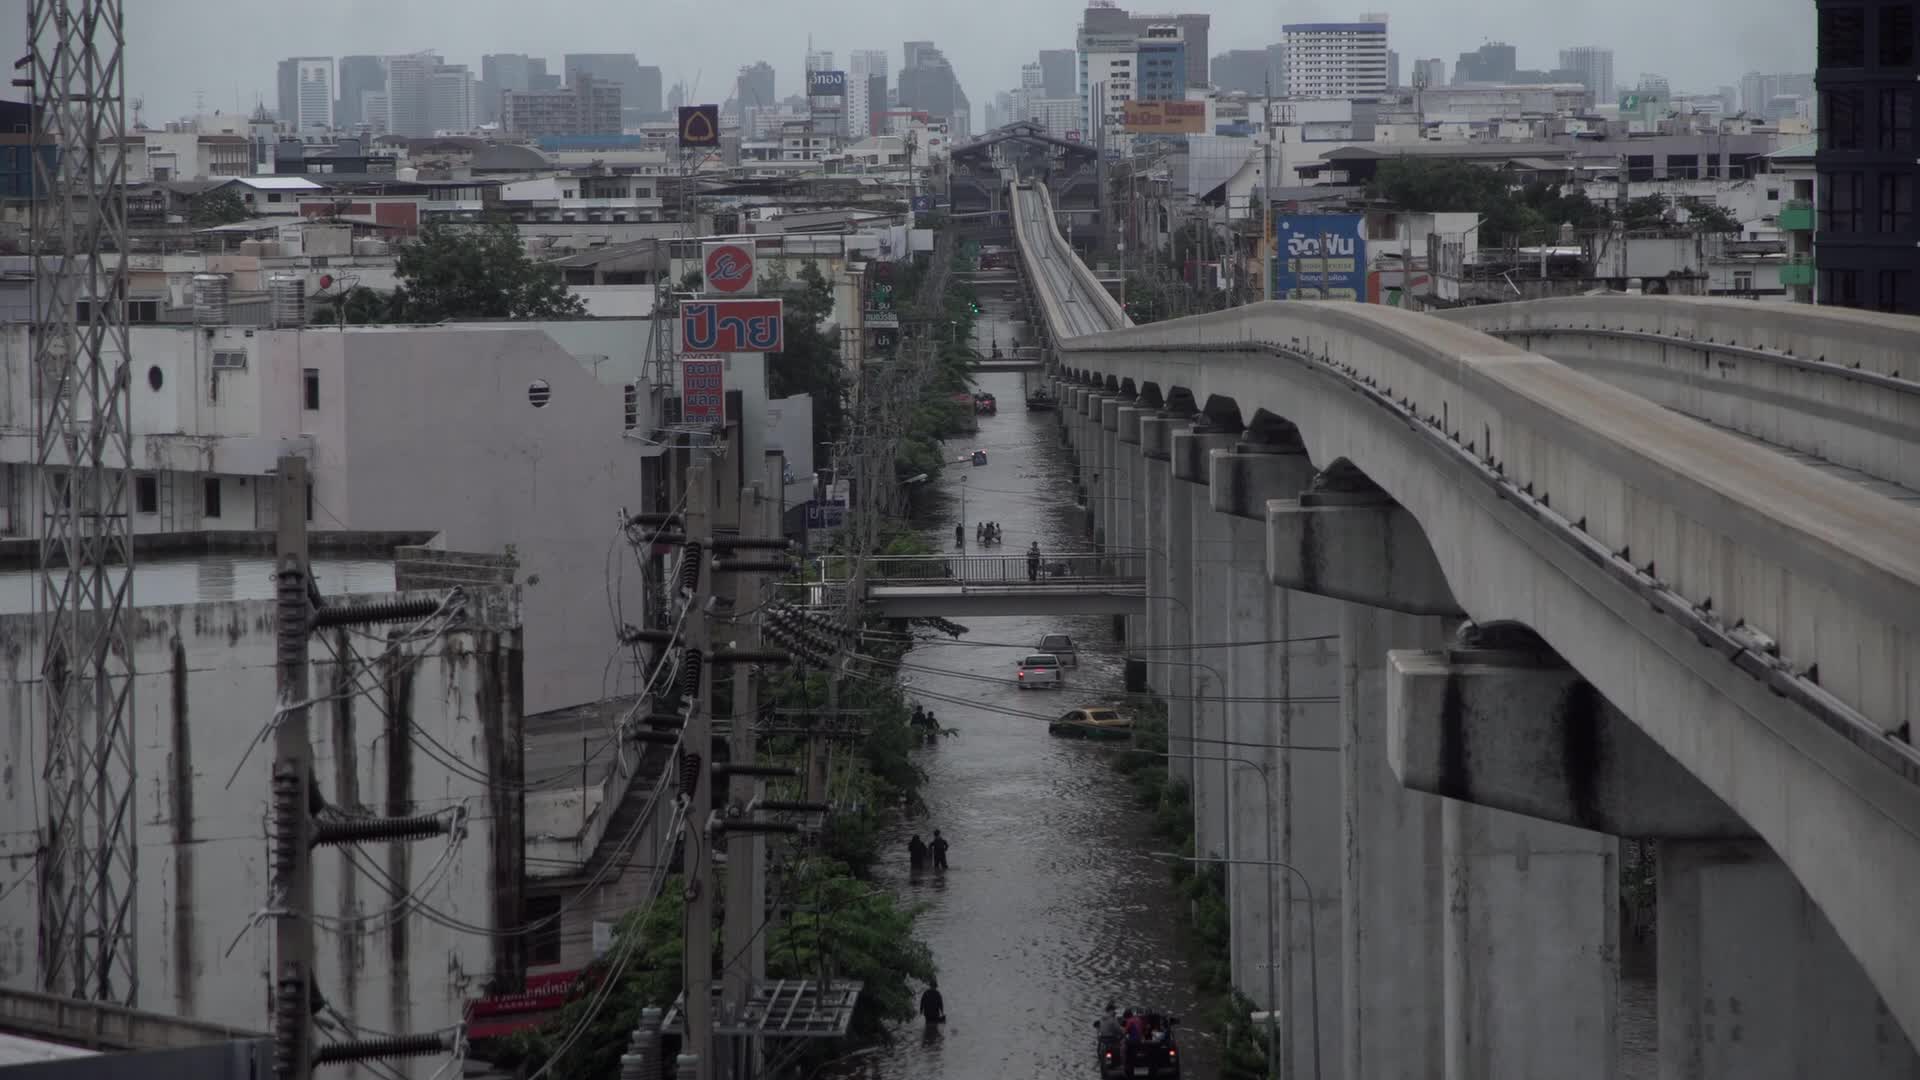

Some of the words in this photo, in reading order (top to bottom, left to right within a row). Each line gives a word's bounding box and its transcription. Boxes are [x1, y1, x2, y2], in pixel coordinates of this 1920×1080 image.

[1288, 231, 1355, 256] จัดฟัน
[683, 303, 778, 350] ป้าย
